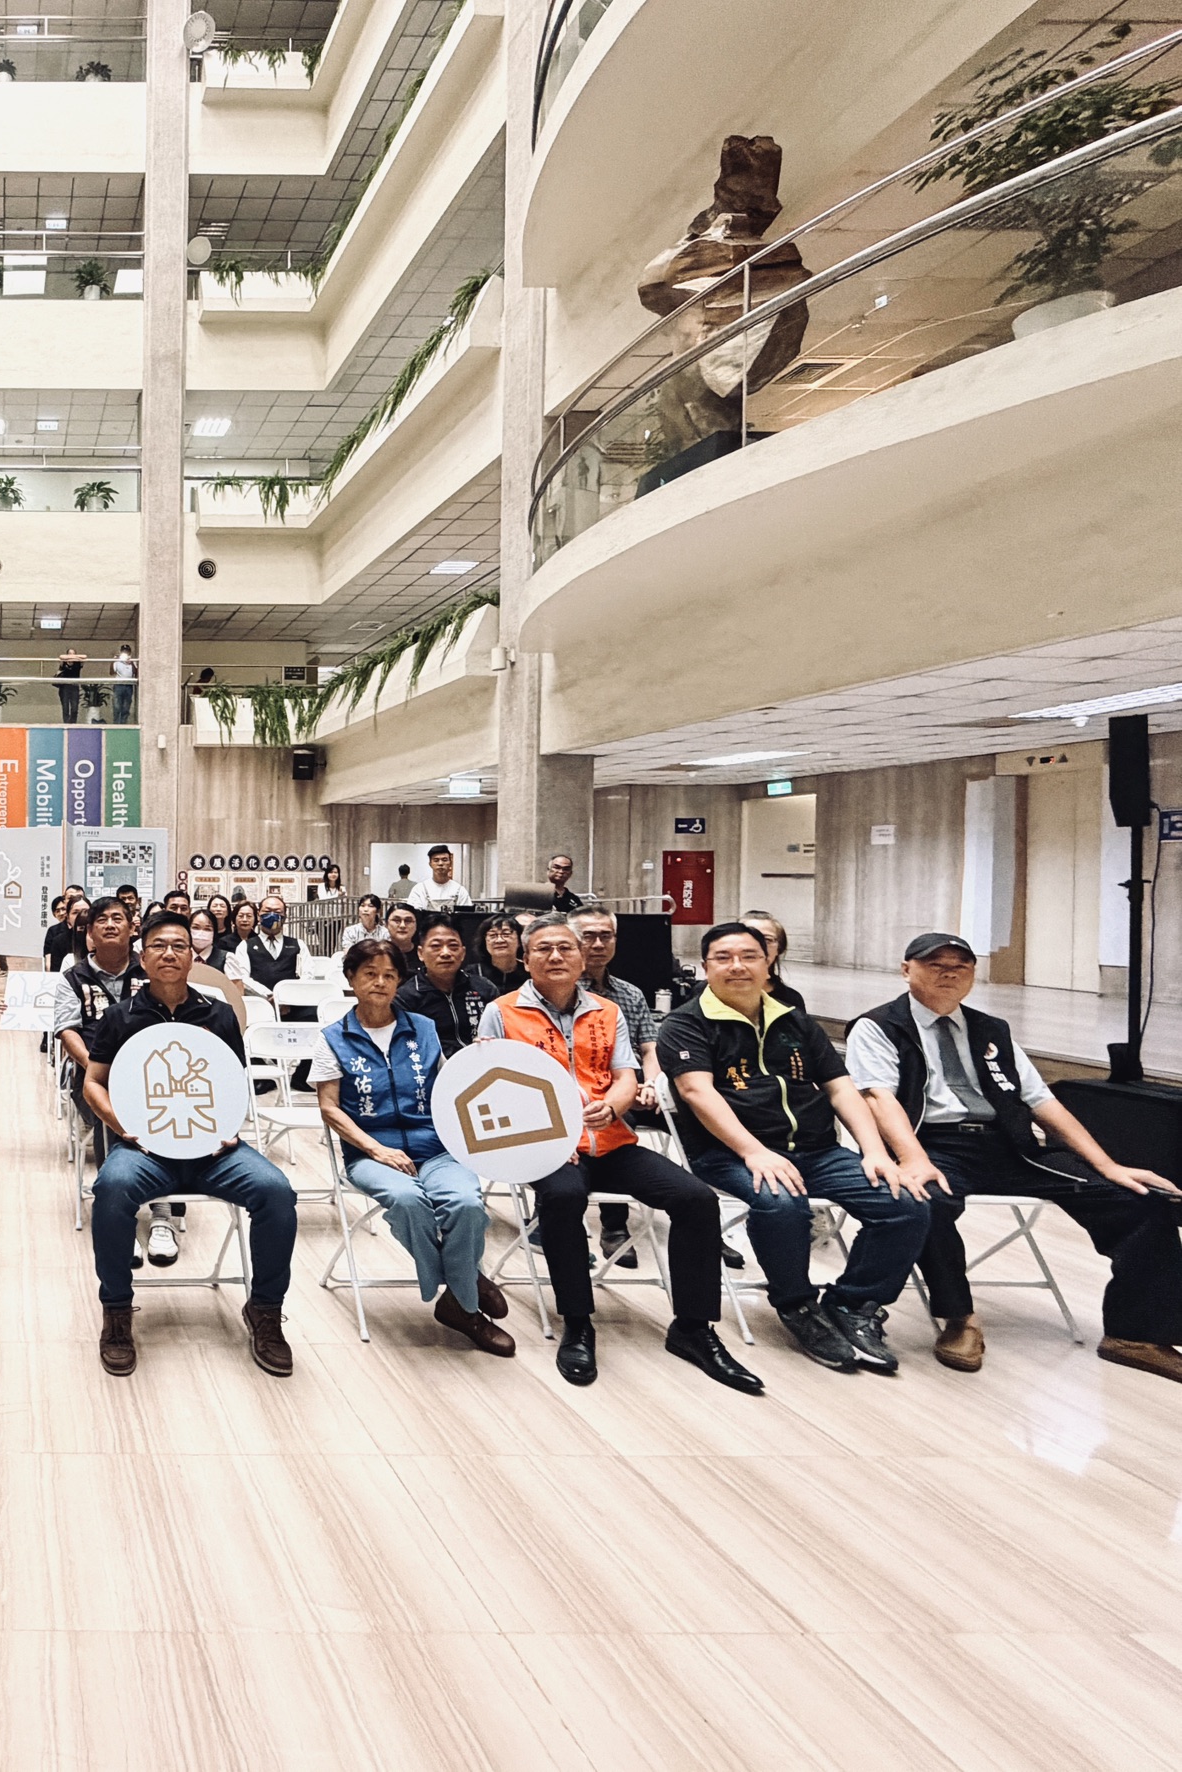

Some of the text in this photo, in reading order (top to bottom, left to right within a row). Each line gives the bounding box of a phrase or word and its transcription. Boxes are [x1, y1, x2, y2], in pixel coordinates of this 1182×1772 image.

[71, 759, 95, 827] Opport
[408, 1051, 427, 1115] 台中市議員
